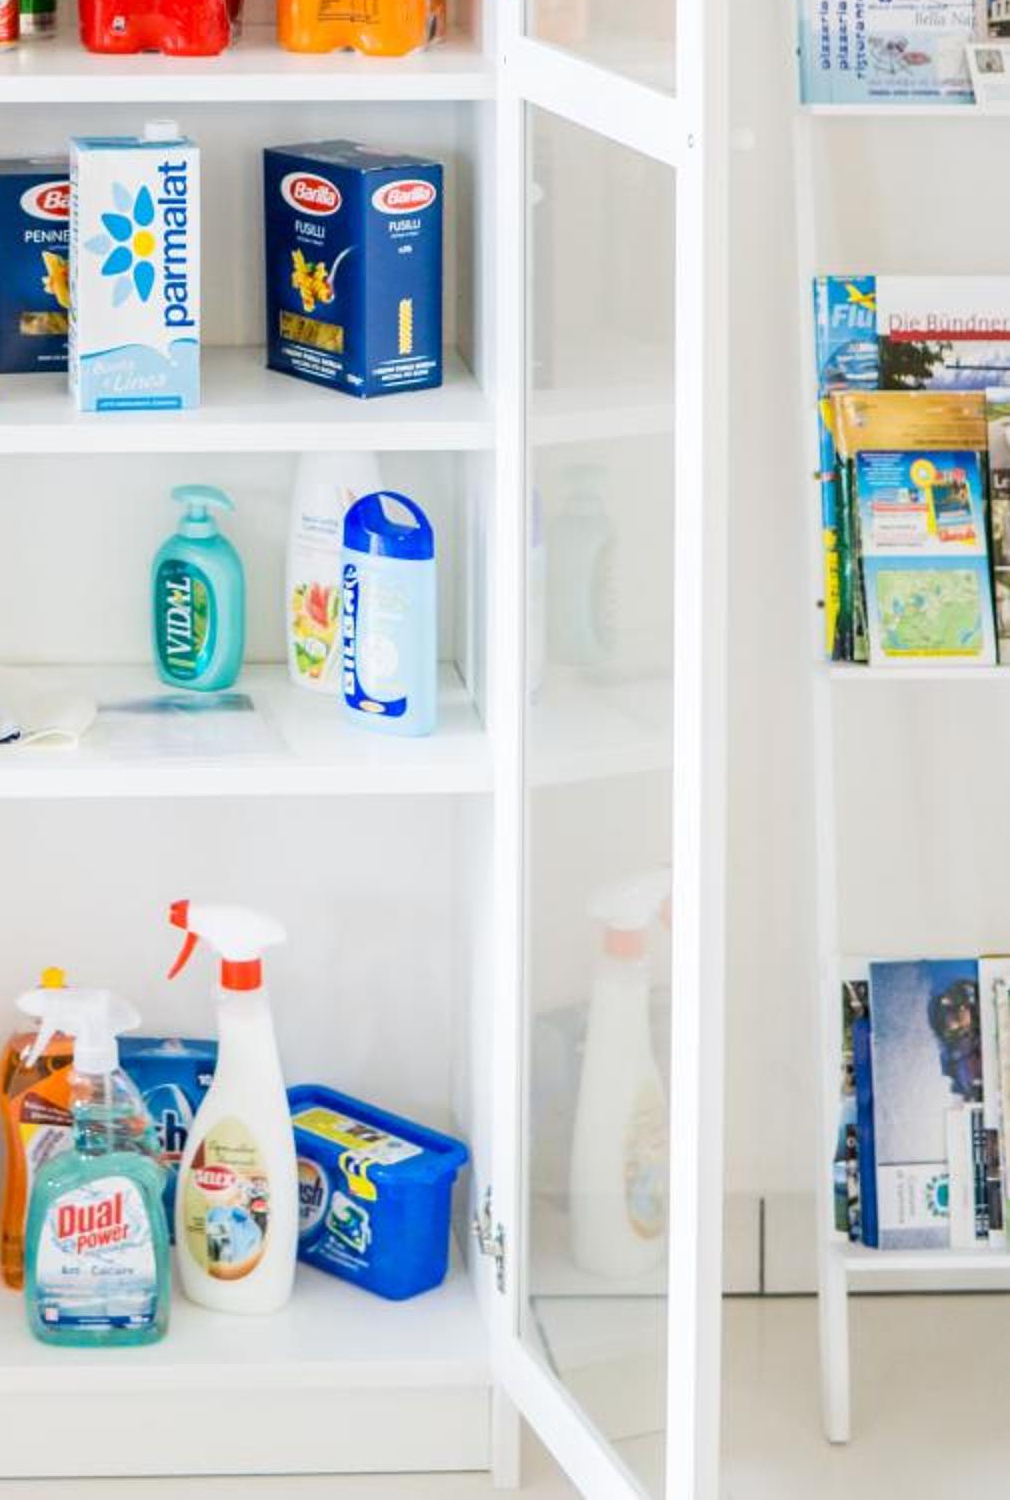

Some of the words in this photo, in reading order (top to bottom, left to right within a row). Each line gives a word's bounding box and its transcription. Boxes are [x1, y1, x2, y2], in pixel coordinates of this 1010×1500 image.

[293, 180, 336, 207] Barilla
[386, 184, 432, 205] Barilla
[294, 218, 325, 239] FUSILLI
[389, 218, 421, 233] FUSILLI
[157, 160, 195, 327] parmalat
[890, 313, 921, 331] Die
[166, 573, 192, 657] VIDAL
[58, 1191, 123, 1239] Dual
